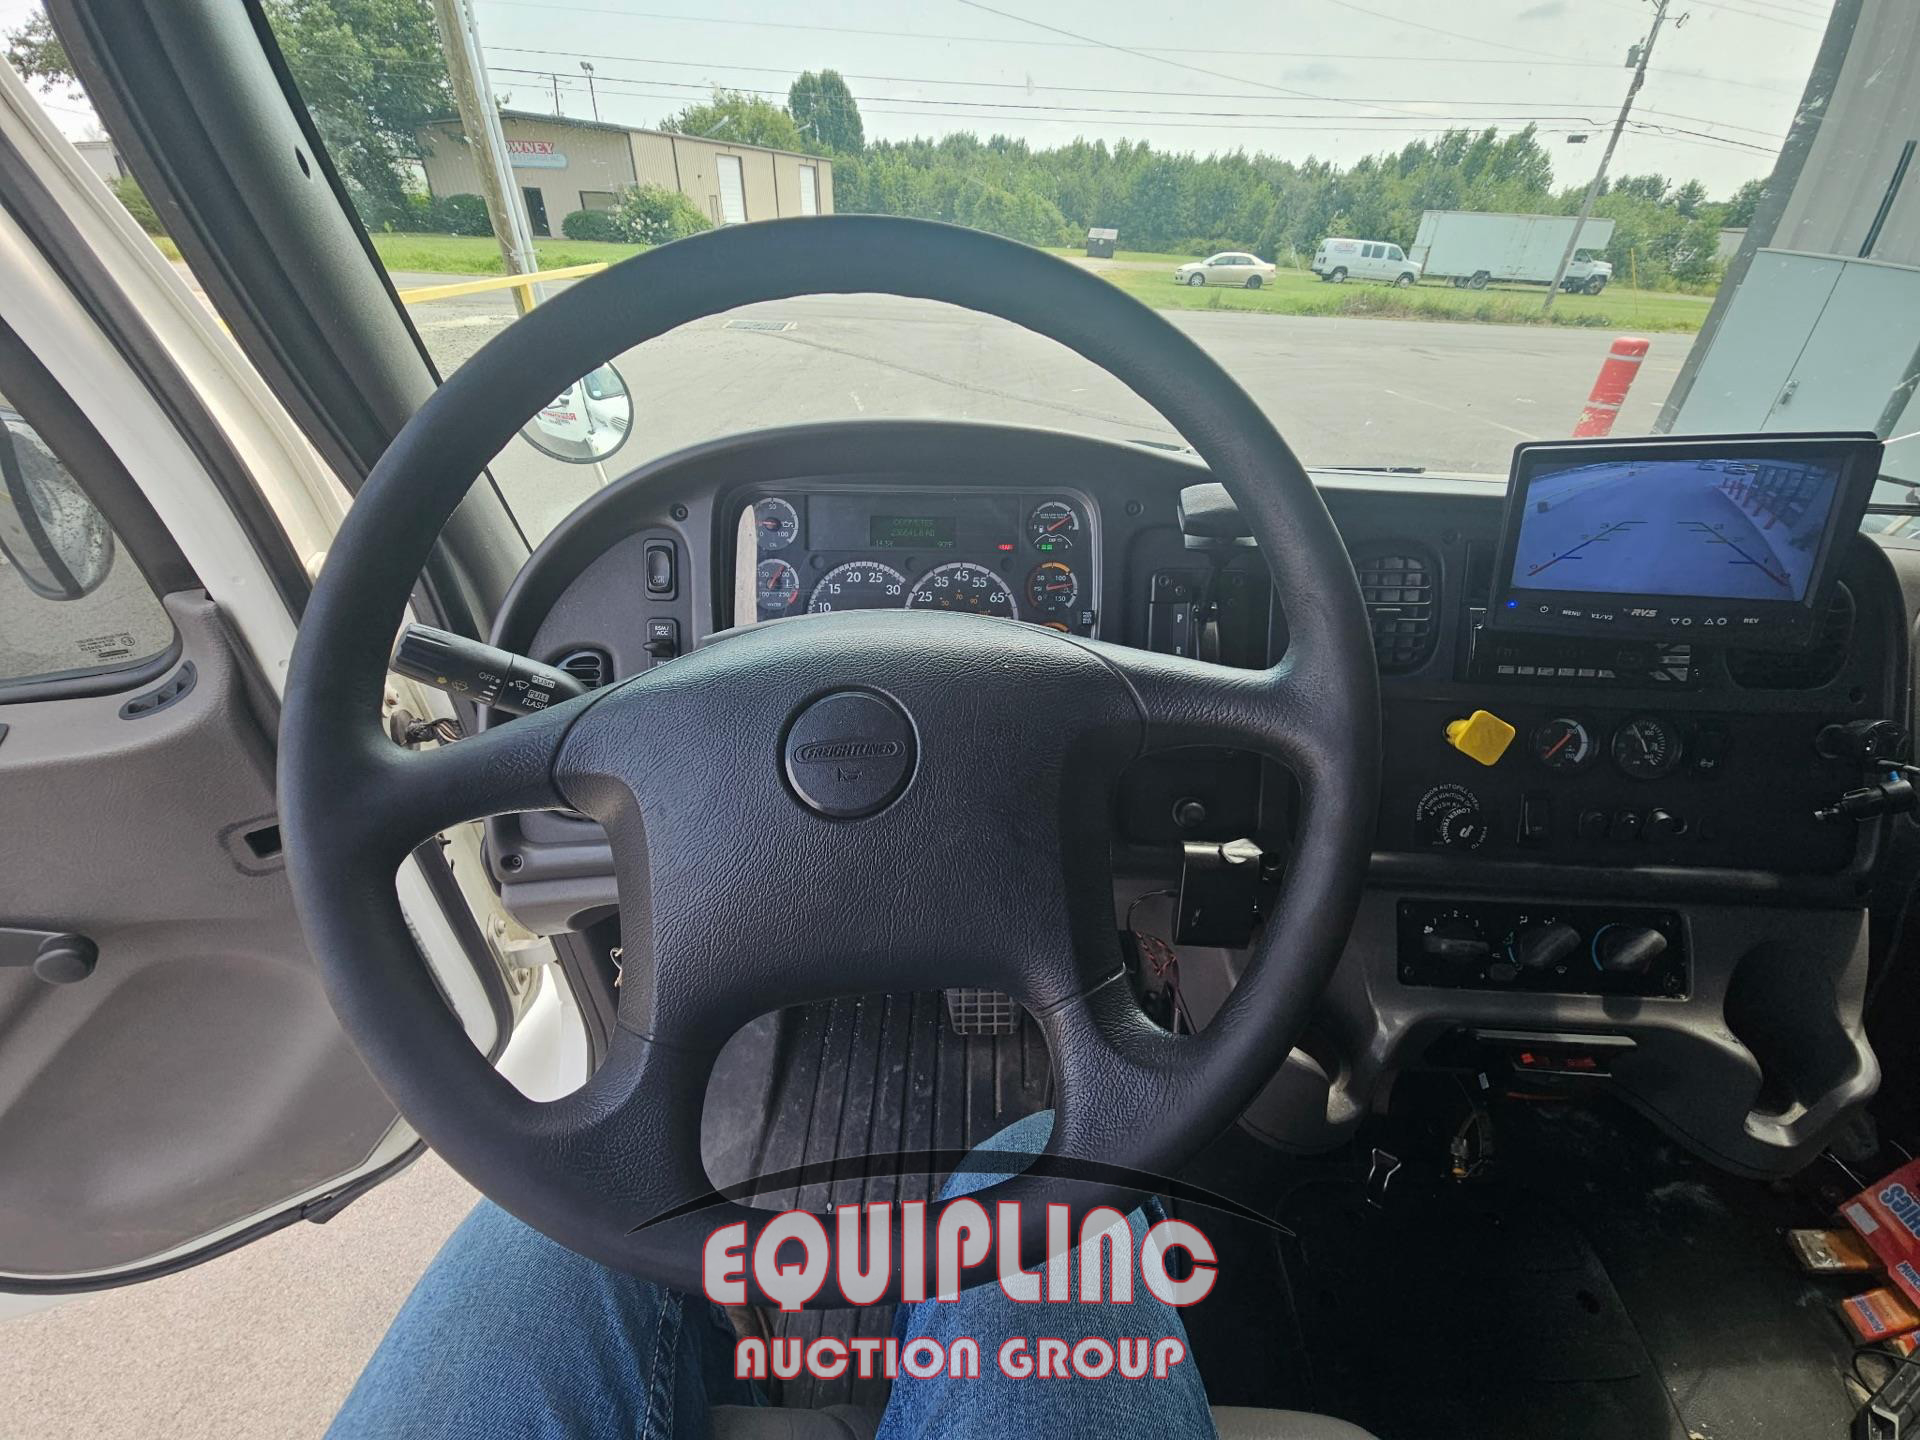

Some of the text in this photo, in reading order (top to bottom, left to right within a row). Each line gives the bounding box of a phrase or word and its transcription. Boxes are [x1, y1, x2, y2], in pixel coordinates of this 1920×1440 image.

[846, 571, 862, 583] 20
[868, 572, 883, 583] 25
[953, 570, 969, 581] 45
[934, 576, 949, 588] 35
[972, 576, 987, 588] 55
[828, 583, 841, 594] 15
[885, 584, 901, 595] 30
[918, 591, 933, 602] 25
[989, 592, 1005, 603] 65
[818, 602, 832, 613] 10
[1562, 609, 1582, 617] MENU
[1630, 608, 1658, 618] RVS
[1176, 613, 1183, 623] P
[478, 671, 496, 682] OFF
[522, 698, 549, 710] FLASH
